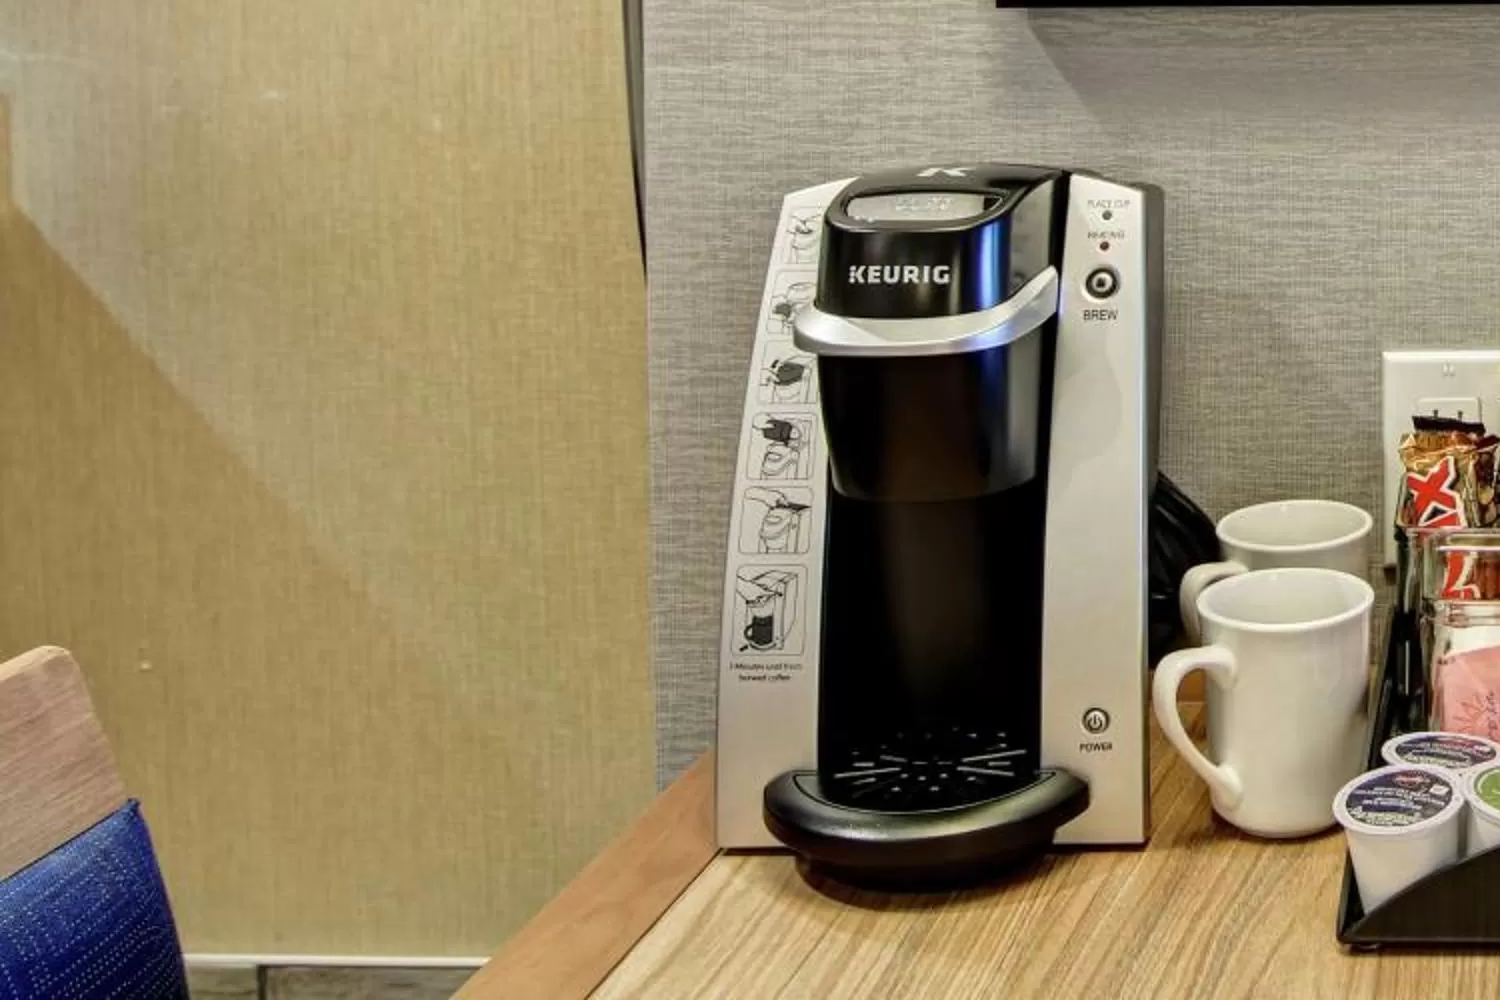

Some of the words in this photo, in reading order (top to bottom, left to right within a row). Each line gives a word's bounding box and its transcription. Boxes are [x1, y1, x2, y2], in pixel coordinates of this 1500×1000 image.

[848, 264, 950, 285] KEURIG
[1083, 308, 1118, 321] BREW
[1079, 742, 1112, 752] POWER
